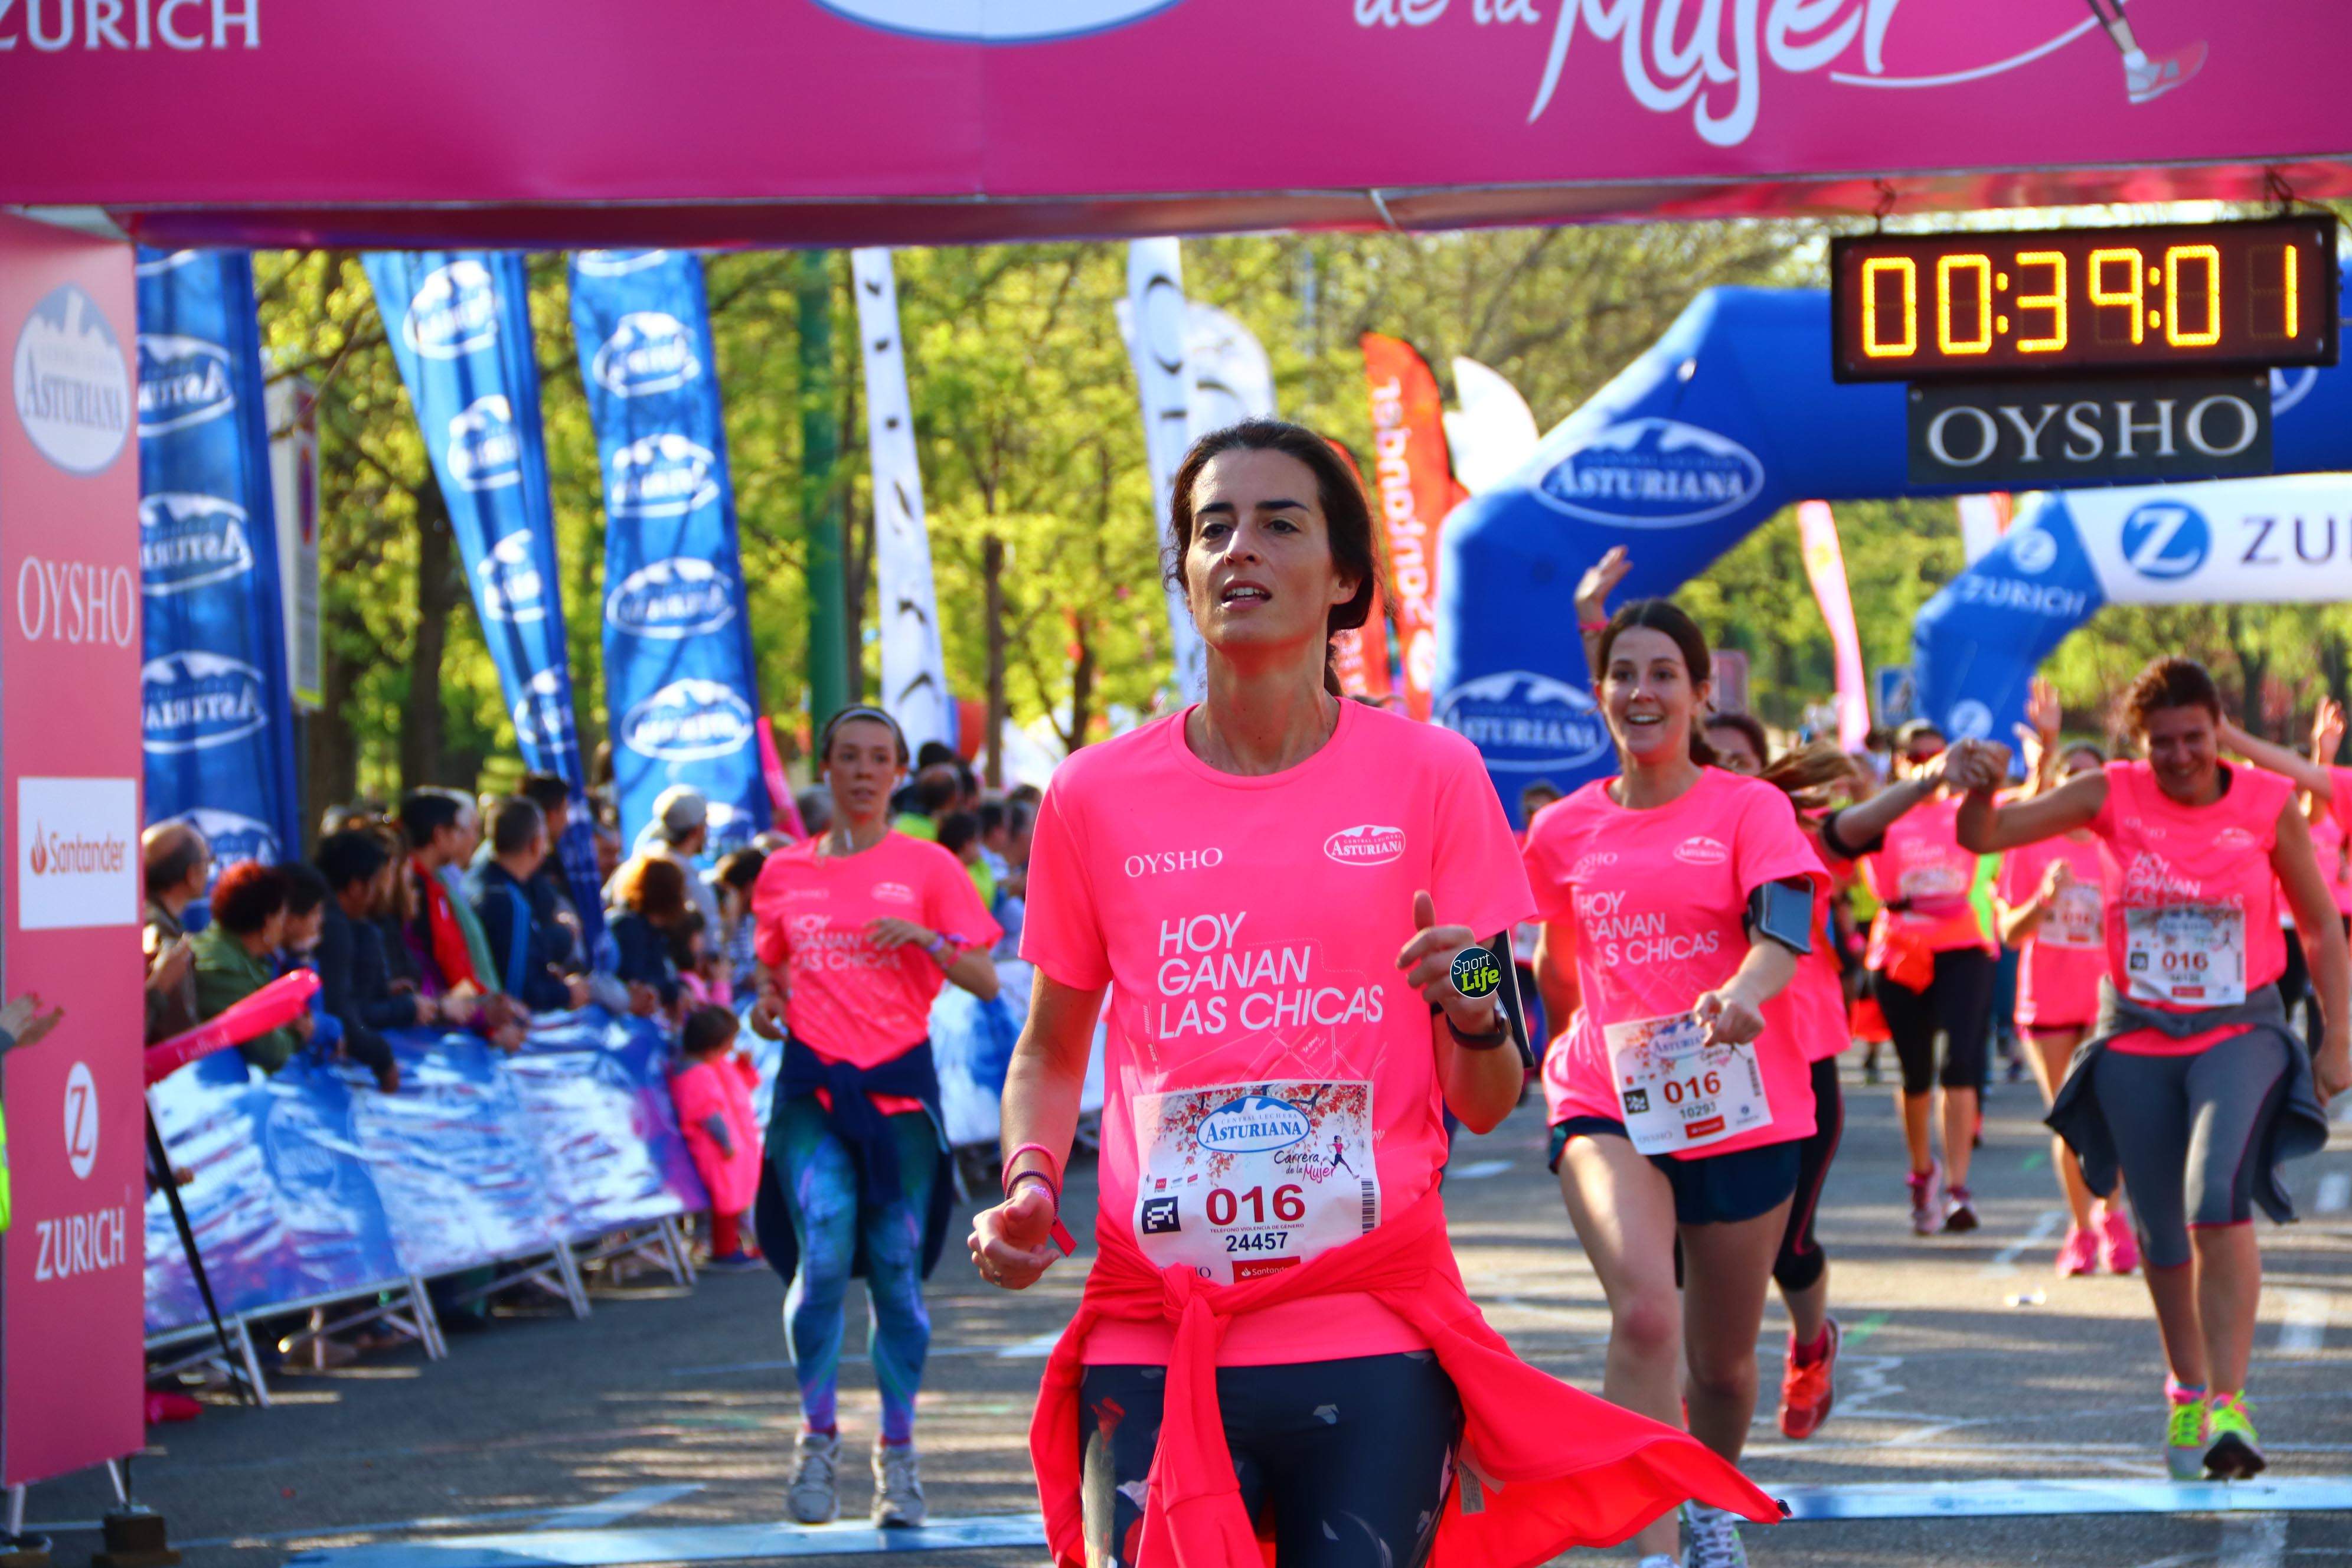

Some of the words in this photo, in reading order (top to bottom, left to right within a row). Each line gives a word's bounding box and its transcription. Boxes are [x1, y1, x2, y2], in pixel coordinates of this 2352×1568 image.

[1863, 244, 2298, 357] 00:39:01
[22, 345, 123, 434] ASTURIANA
[1927, 394, 2259, 467] OYSHO
[1547, 458, 1747, 502] ASTURIANA
[2241, 517, 2352, 565] ZU
[17, 556, 135, 646] OYSHO
[1962, 573, 2088, 619] ZURICH
[48, 832, 126, 874] Santander
[1124, 847, 1223, 878] OYSHO
[1331, 839, 1403, 857] ASTURIANA
[1579, 890, 1625, 917] HOY
[1158, 911, 1246, 956] HOY
[1626, 929, 1720, 965] CHICAS
[1158, 946, 1311, 997] GANAN
[2161, 950, 2209, 971] 016
[1159, 996, 1227, 1040] LAS
[1240, 984, 1384, 1031] CHICAS
[1664, 1070, 1721, 1104] 016
[1205, 1119, 1302, 1144] ASTURIANA
[1221, 1115, 1256, 1124] CENTRAL
[1274, 1151, 1319, 1164] Carrera
[1286, 1165, 1295, 1175] de
[1296, 1164, 1303, 1174] la
[1302, 1161, 1337, 1184] Mujer
[1206, 1184, 1305, 1226] 016
[34, 1206, 126, 1282] ZURICH
[1226, 1232, 1288, 1252] 24457
